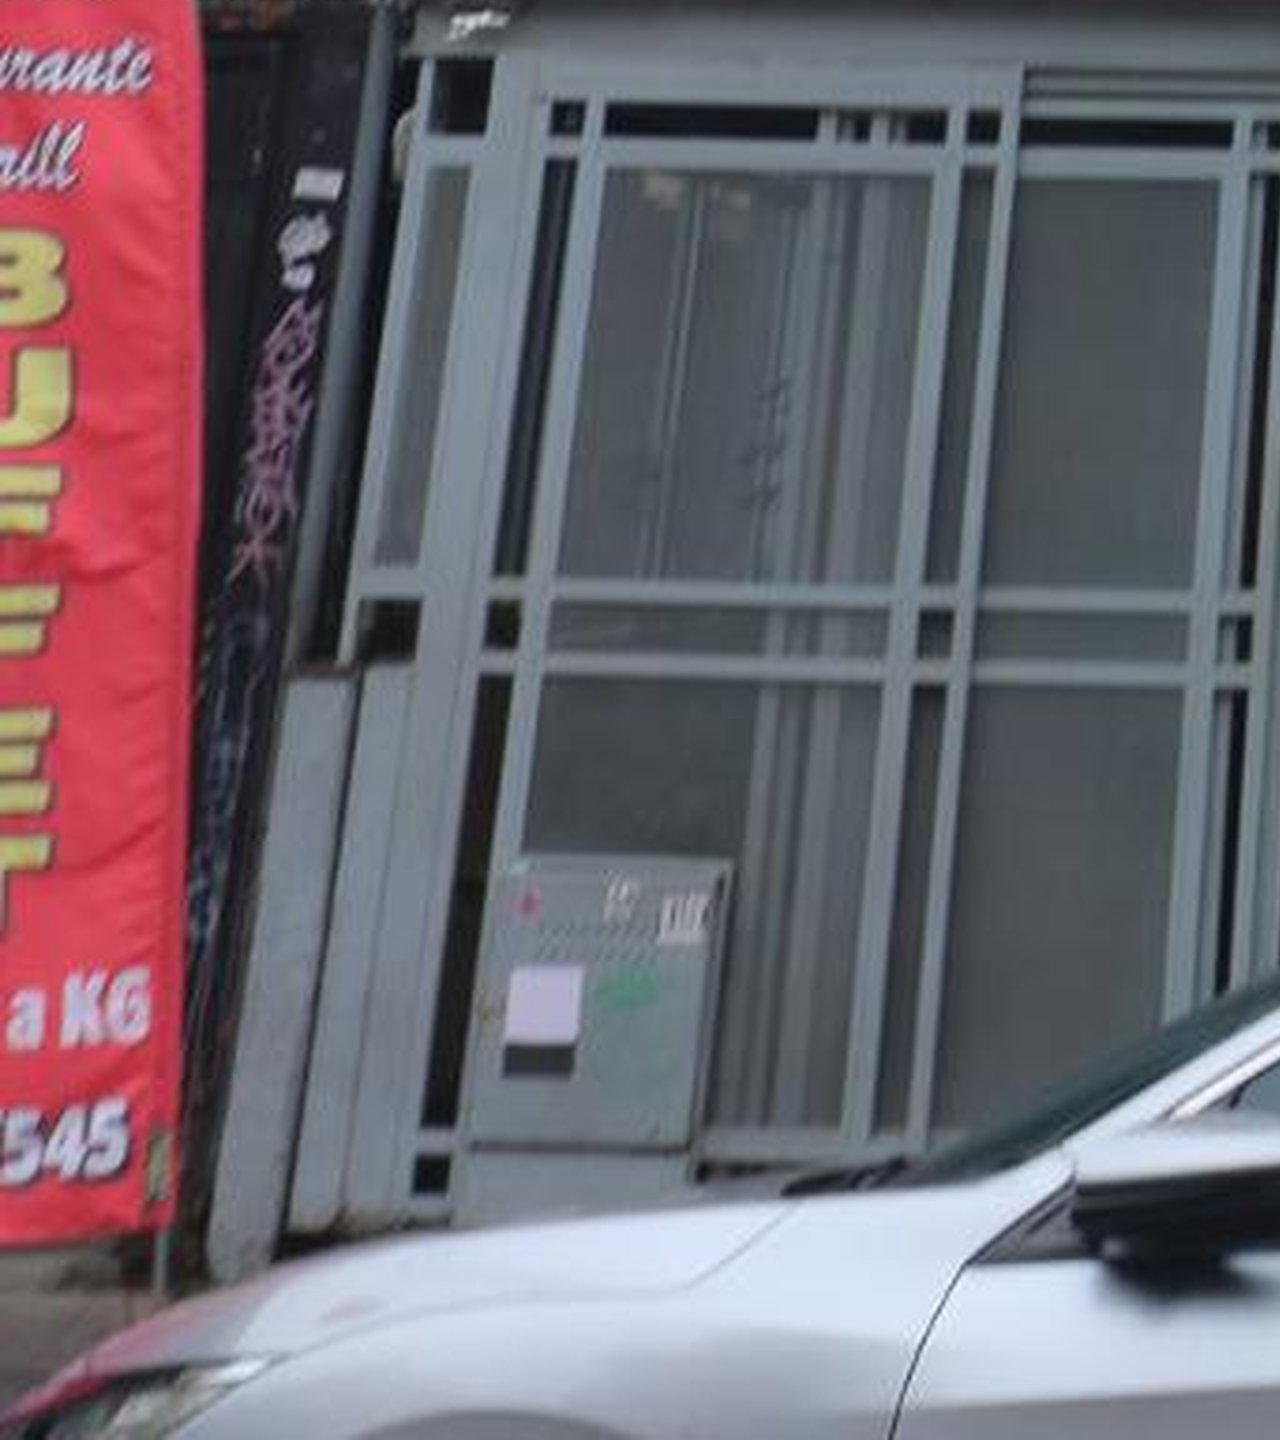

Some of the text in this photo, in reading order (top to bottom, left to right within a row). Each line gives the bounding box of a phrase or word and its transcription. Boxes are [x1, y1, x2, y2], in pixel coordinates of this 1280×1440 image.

[6, 964, 151, 1052] a KG
[0, 1092, 129, 1186] 545
